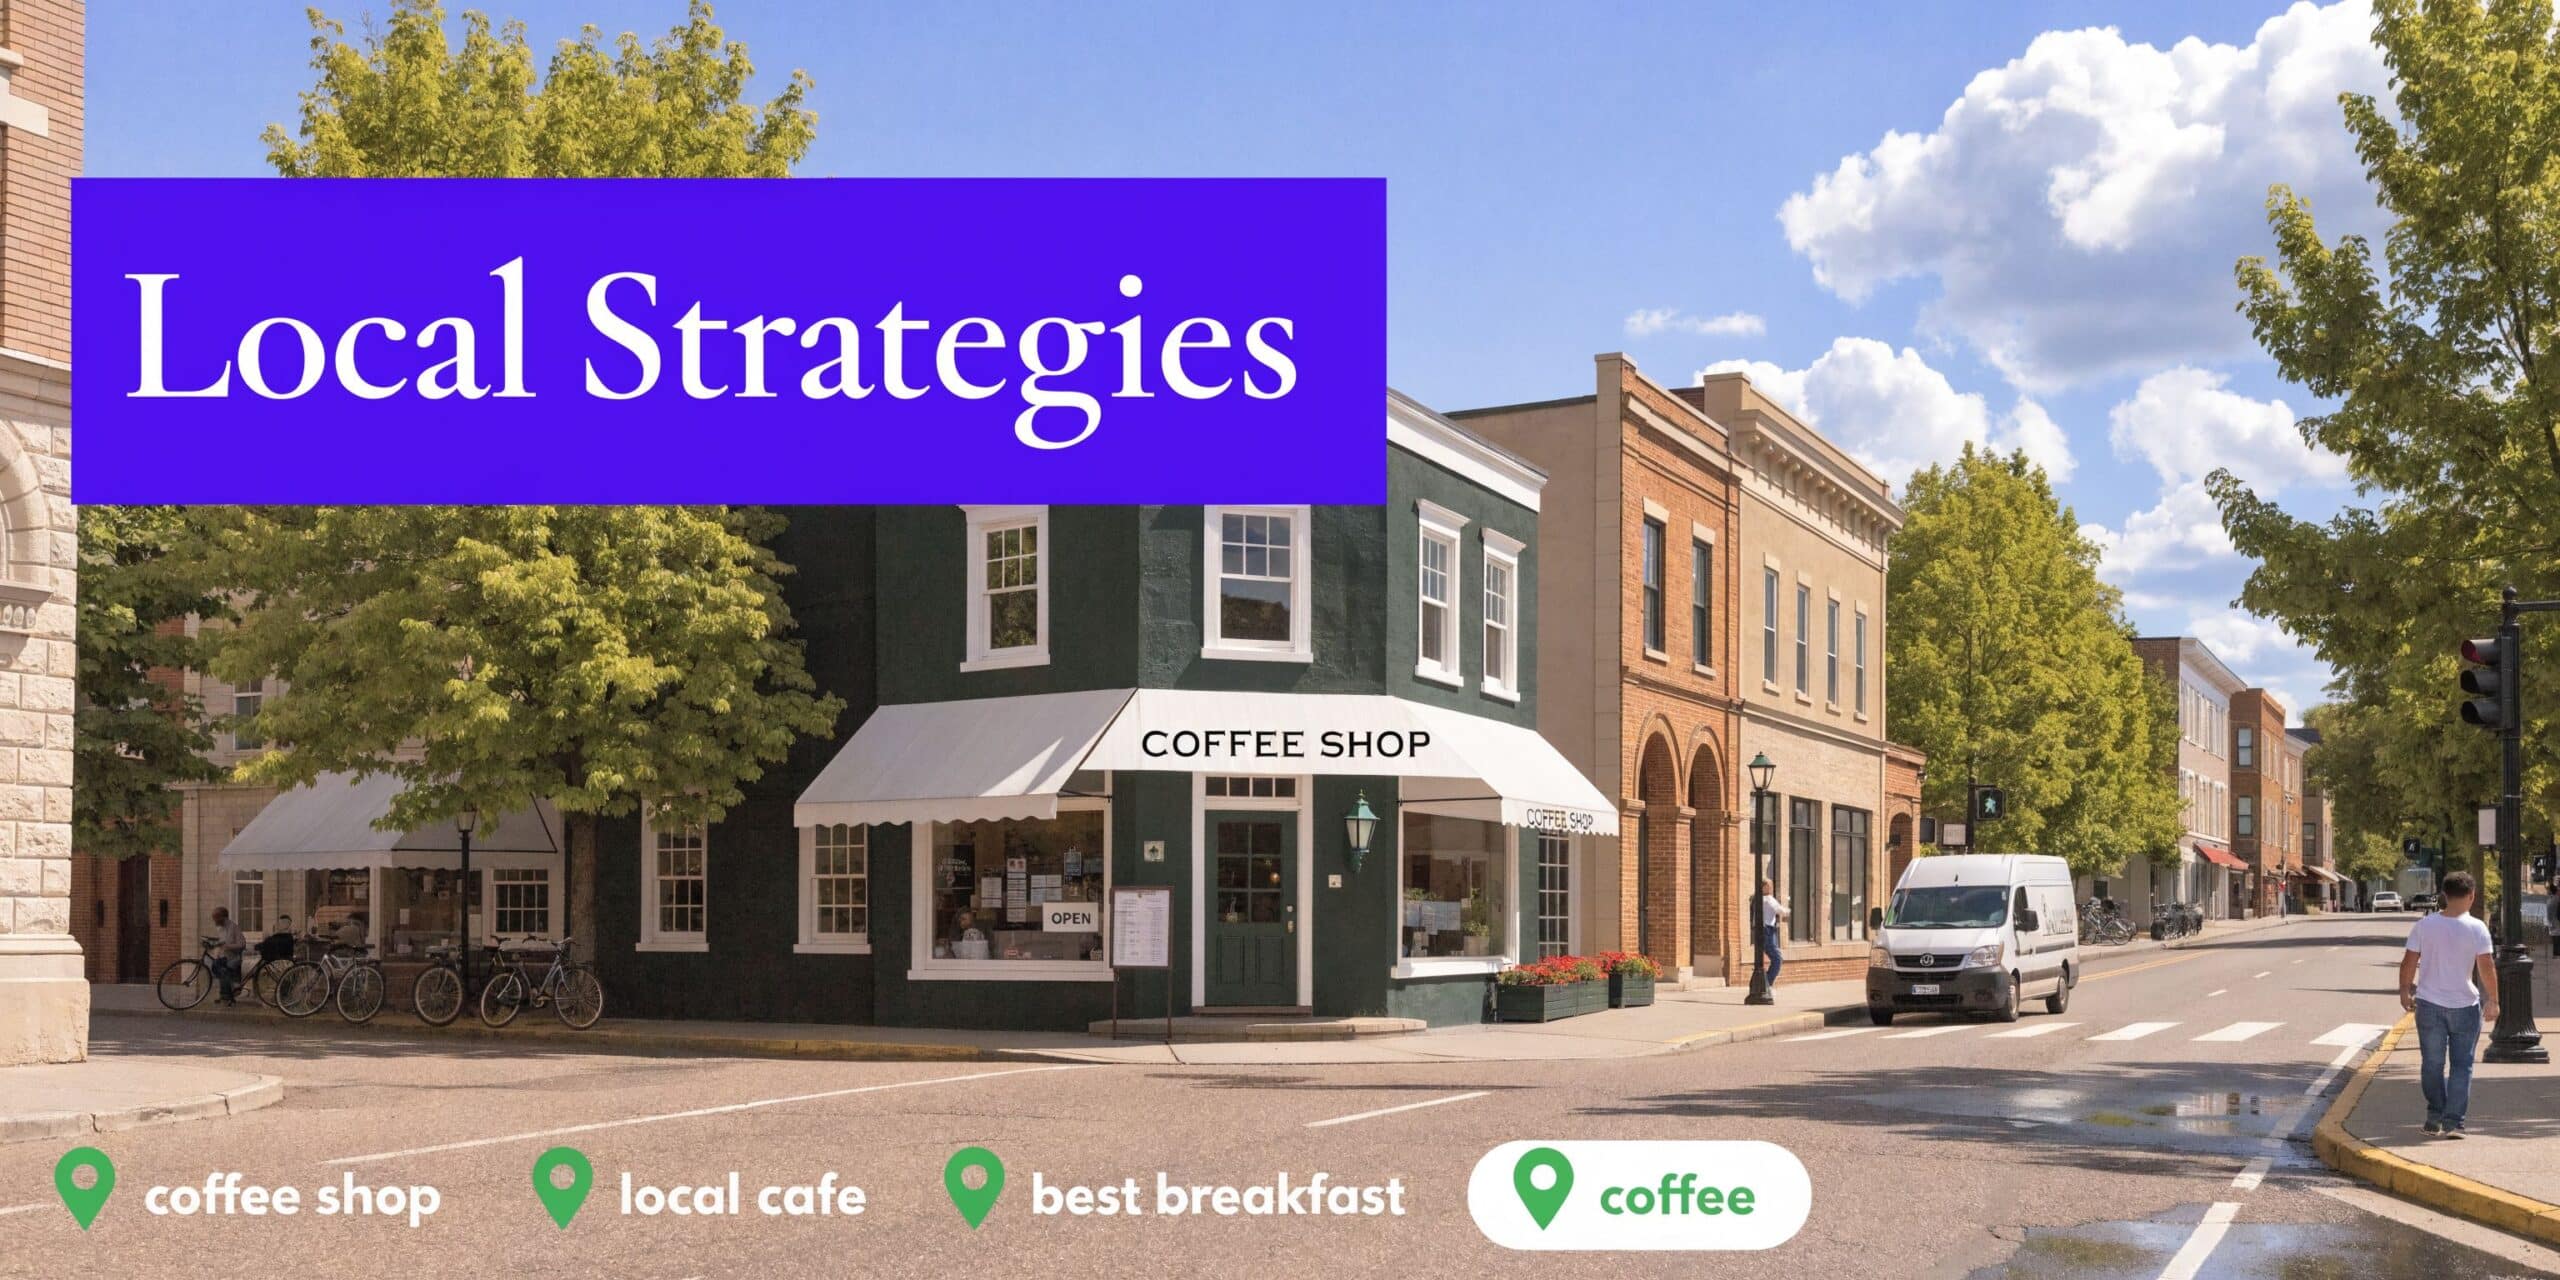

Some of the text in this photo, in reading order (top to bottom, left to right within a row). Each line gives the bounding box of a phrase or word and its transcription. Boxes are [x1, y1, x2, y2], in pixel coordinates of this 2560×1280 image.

[1142, 730, 1430, 758] COFFEE SHOP
[1526, 808, 1567, 829] COFFEE
[1051, 912, 1091, 925] OPEN
